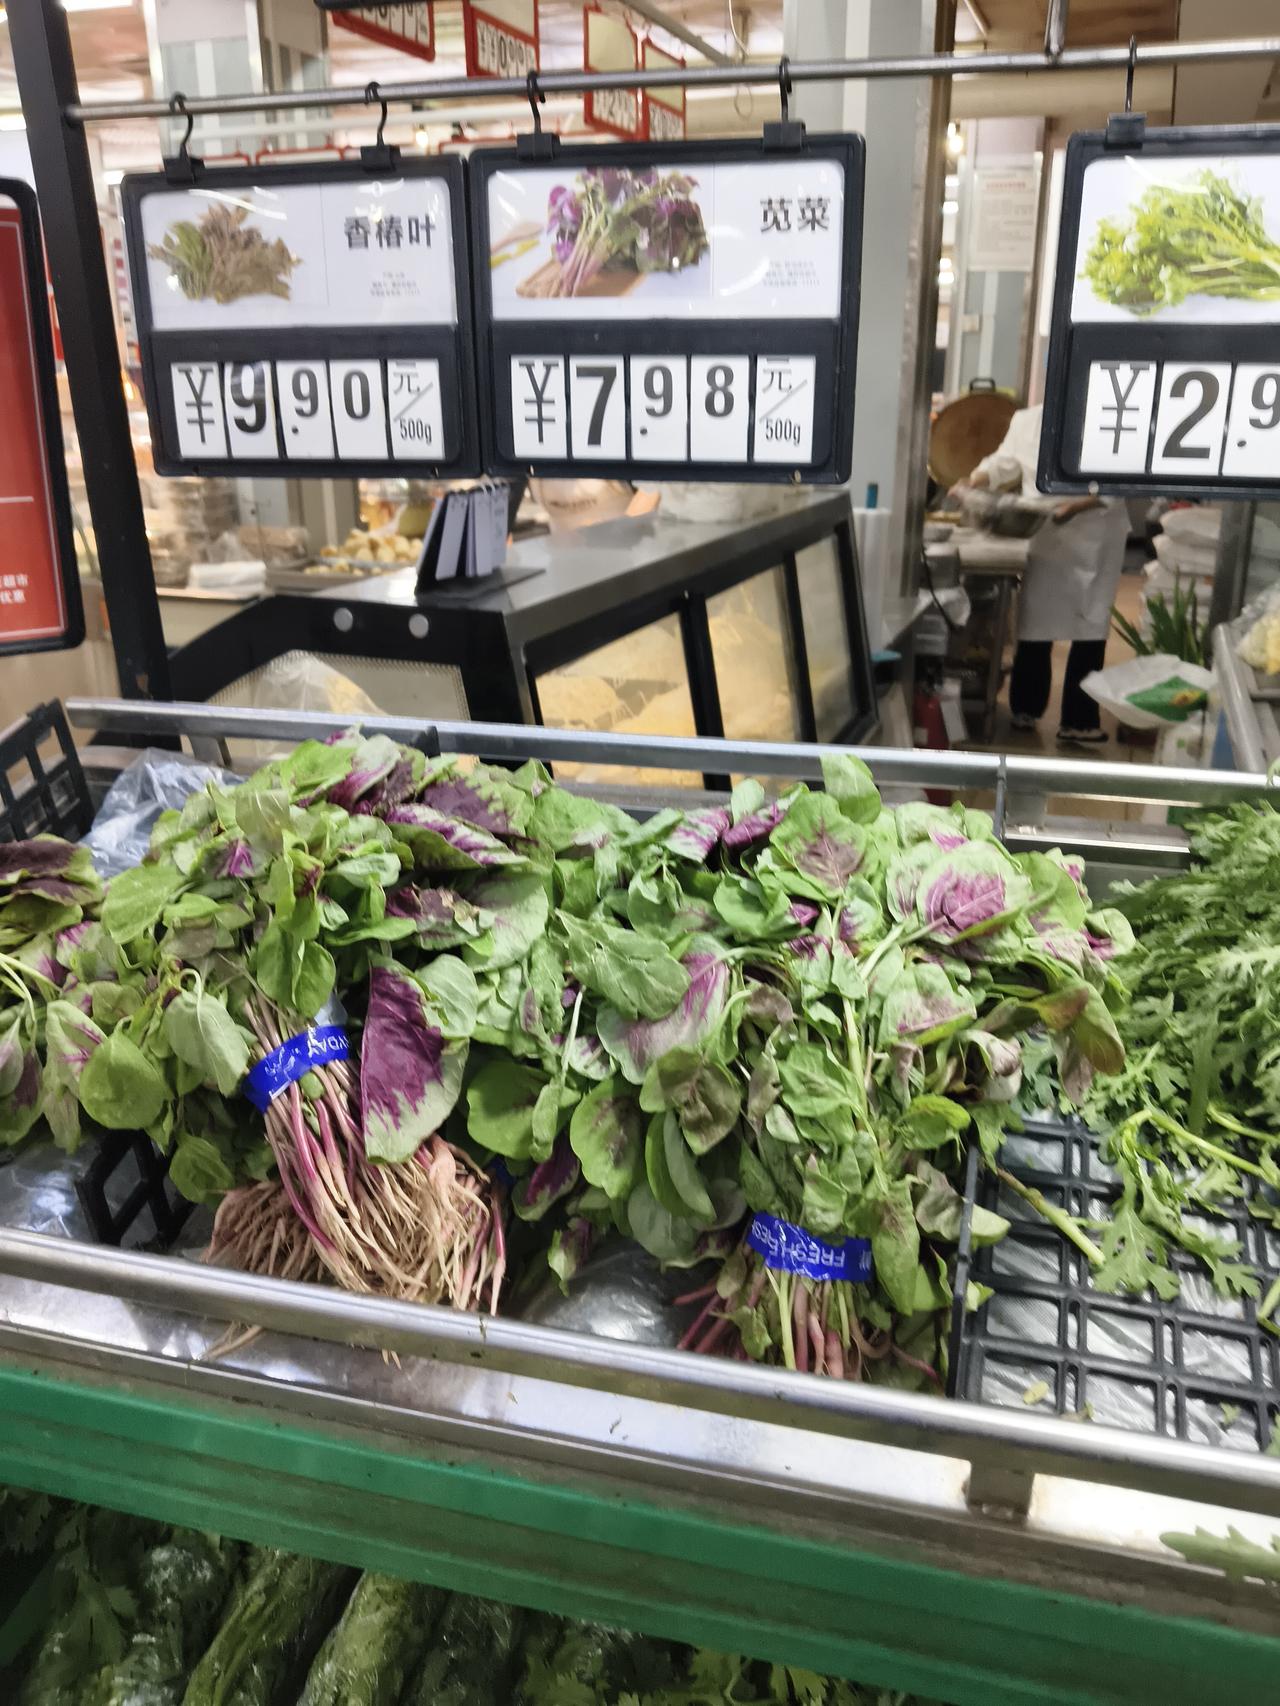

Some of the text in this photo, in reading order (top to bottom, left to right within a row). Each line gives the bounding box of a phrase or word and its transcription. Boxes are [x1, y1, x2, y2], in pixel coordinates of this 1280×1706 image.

[344, 213, 436, 249] 香椿叶
[760, 196, 831, 233] 苋菜
